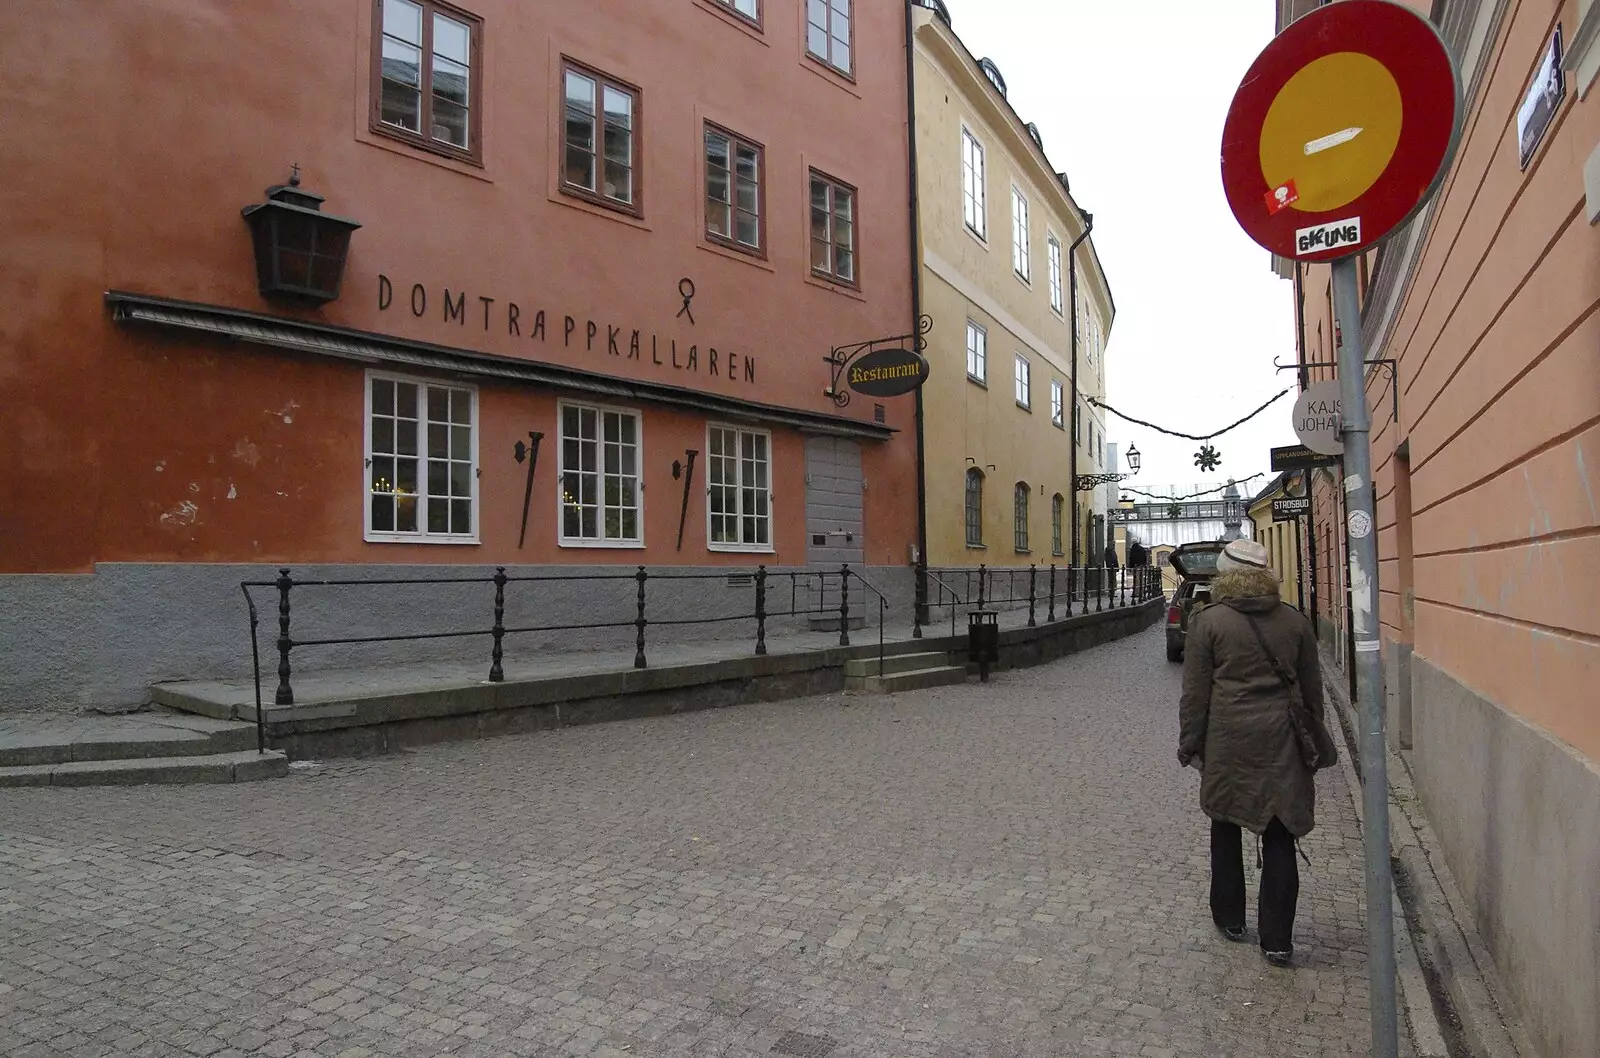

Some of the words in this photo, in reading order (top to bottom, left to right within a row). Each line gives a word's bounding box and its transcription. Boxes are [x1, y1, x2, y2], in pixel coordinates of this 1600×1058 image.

[378, 274, 756, 384] DOMTRAPPKÄLLAREN
[852, 361, 920, 384] Restaurant
[1298, 417, 1342, 431] JOHA
